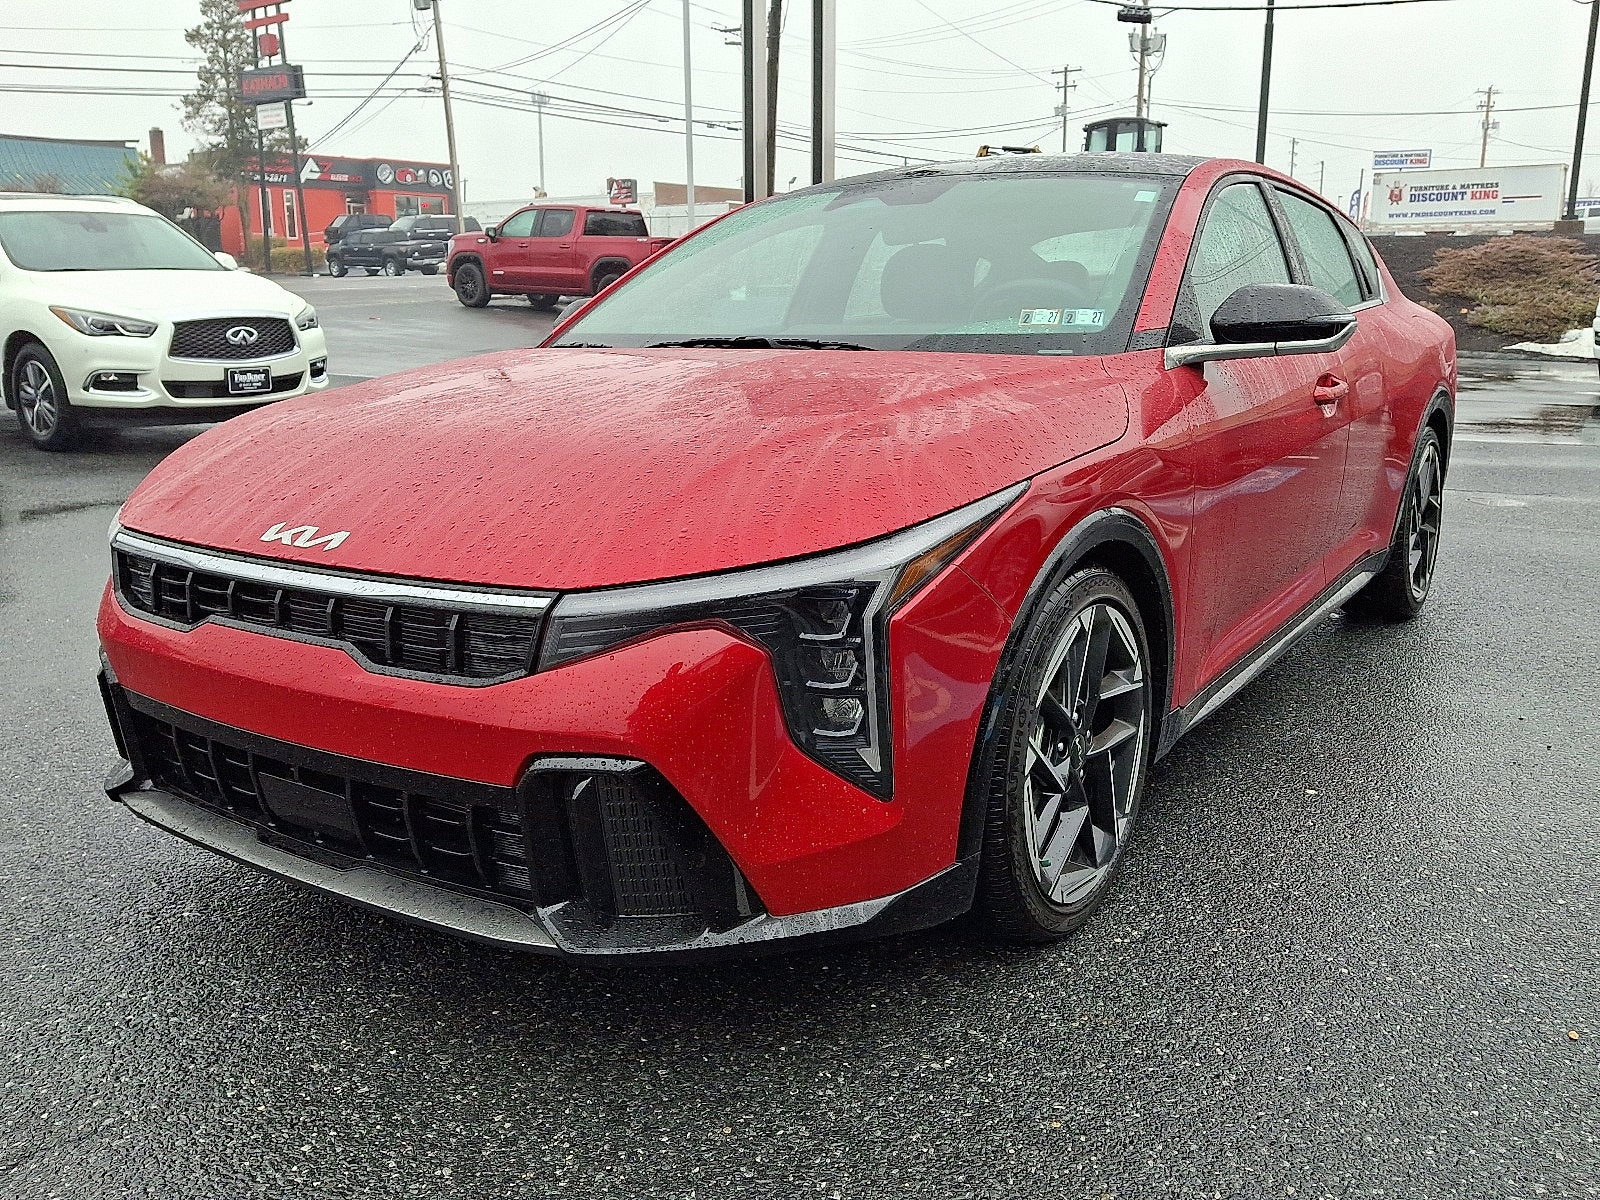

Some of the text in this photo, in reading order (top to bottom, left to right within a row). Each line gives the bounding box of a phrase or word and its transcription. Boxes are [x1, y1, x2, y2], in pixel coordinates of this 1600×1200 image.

[1409, 184, 1450, 192] FURNITURE
[1460, 182, 1499, 190] MATTRESS
[1409, 190, 1499, 203] DISCOUNT KING
[1022, 311, 1059, 324] 2 27
[1067, 312, 1102, 324] 2 27
[260, 521, 351, 552] KIA
